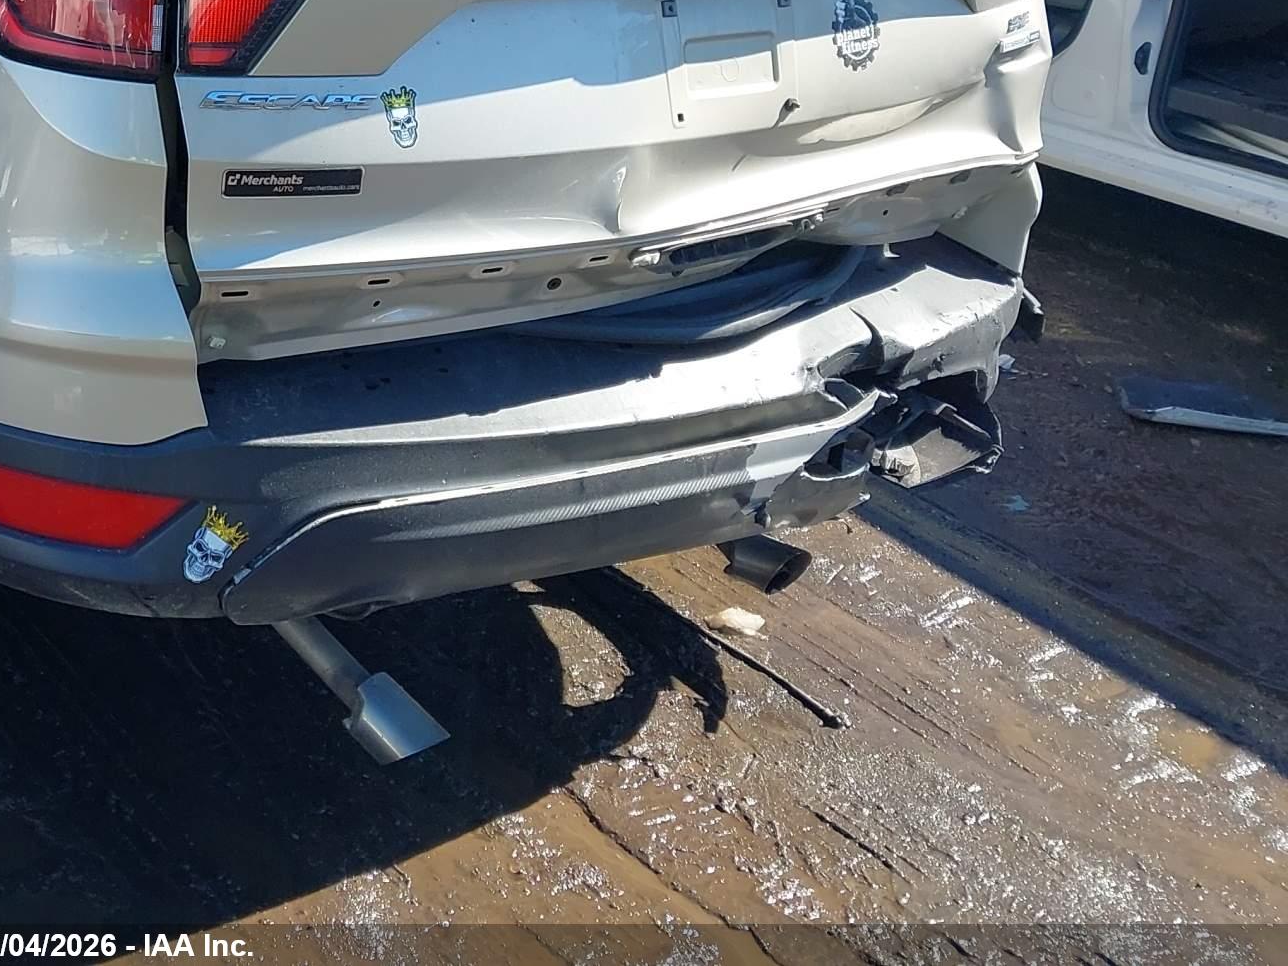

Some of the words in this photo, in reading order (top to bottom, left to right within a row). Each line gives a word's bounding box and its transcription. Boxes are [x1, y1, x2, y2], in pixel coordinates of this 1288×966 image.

[199, 90, 378, 111] ESCAPE
[240, 174, 304, 186] Merchants
[273, 185, 294, 193] AUTO
